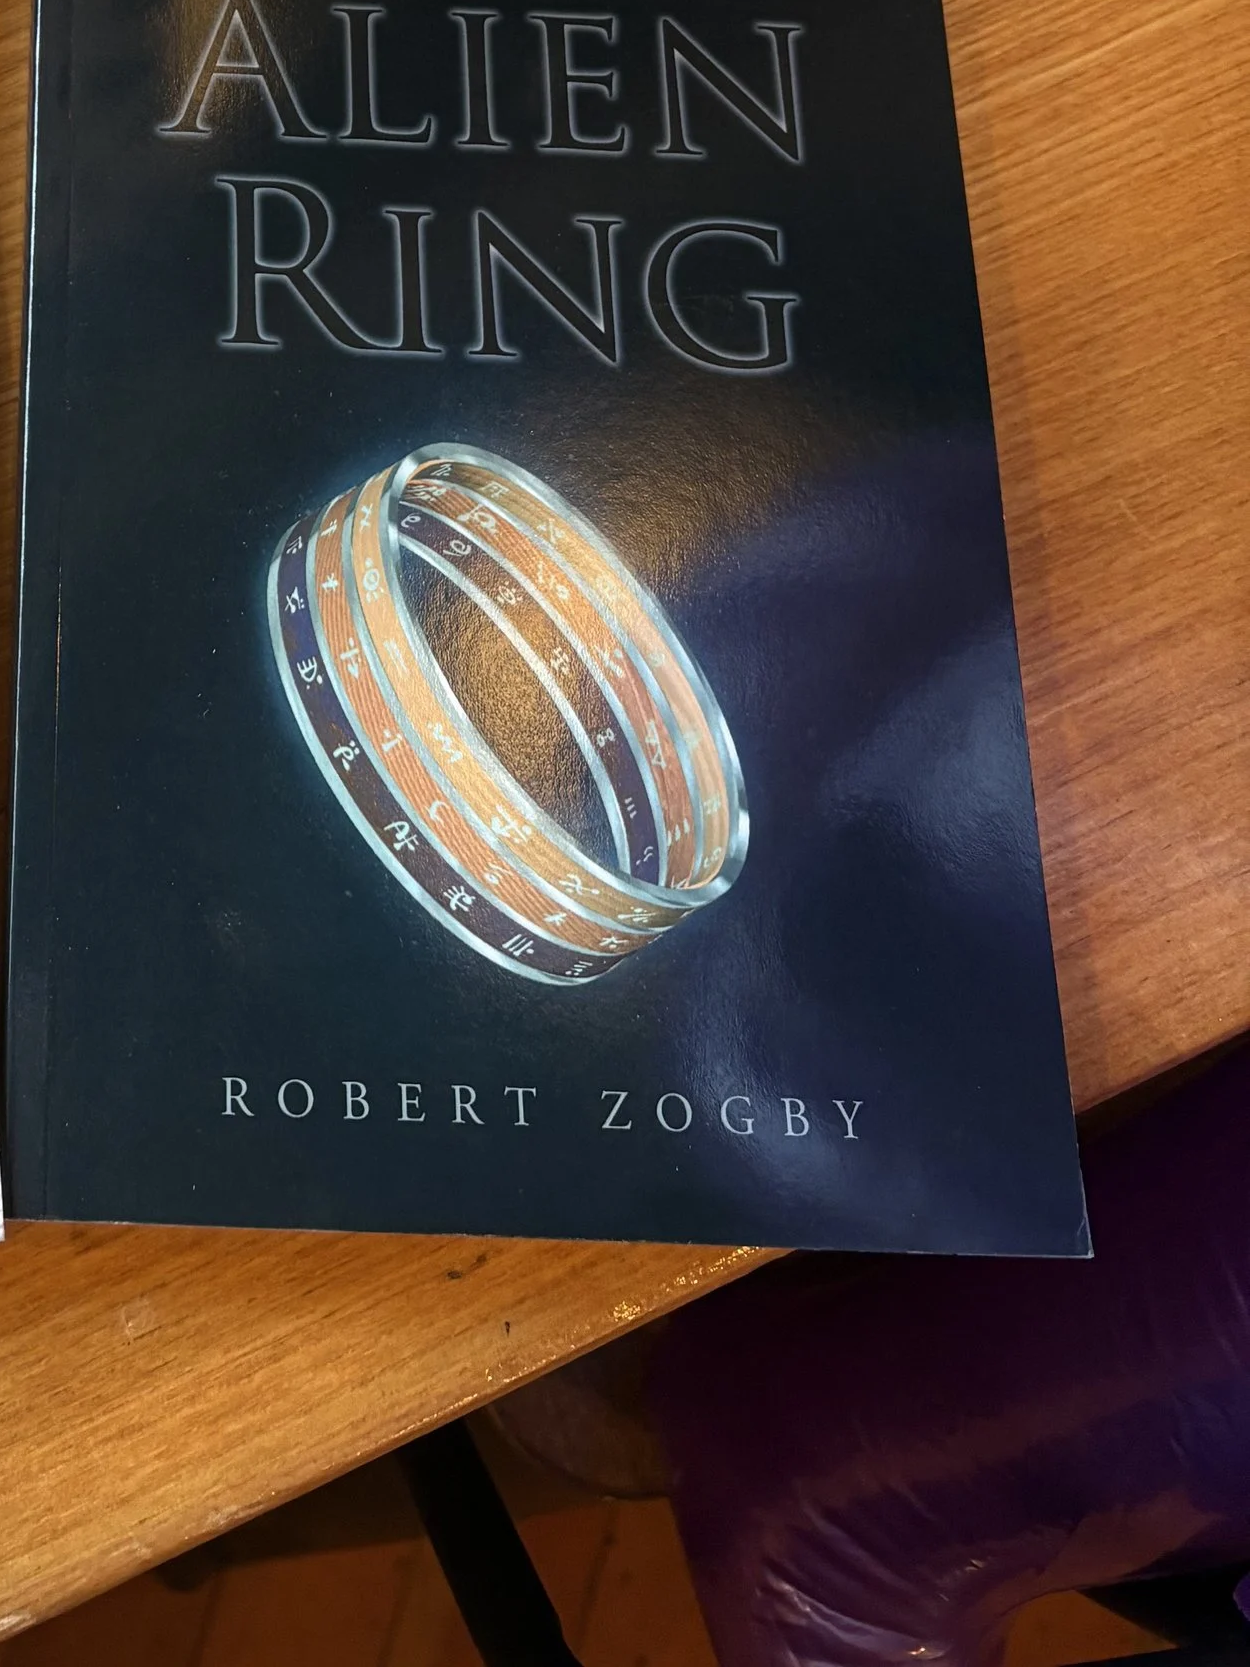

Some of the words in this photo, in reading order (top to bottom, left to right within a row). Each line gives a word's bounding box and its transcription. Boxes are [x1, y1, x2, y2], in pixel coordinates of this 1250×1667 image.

[215, 176, 800, 374] RING
[221, 1076, 537, 1126] ROBERT
[600, 1090, 864, 1139] ZOGBY
